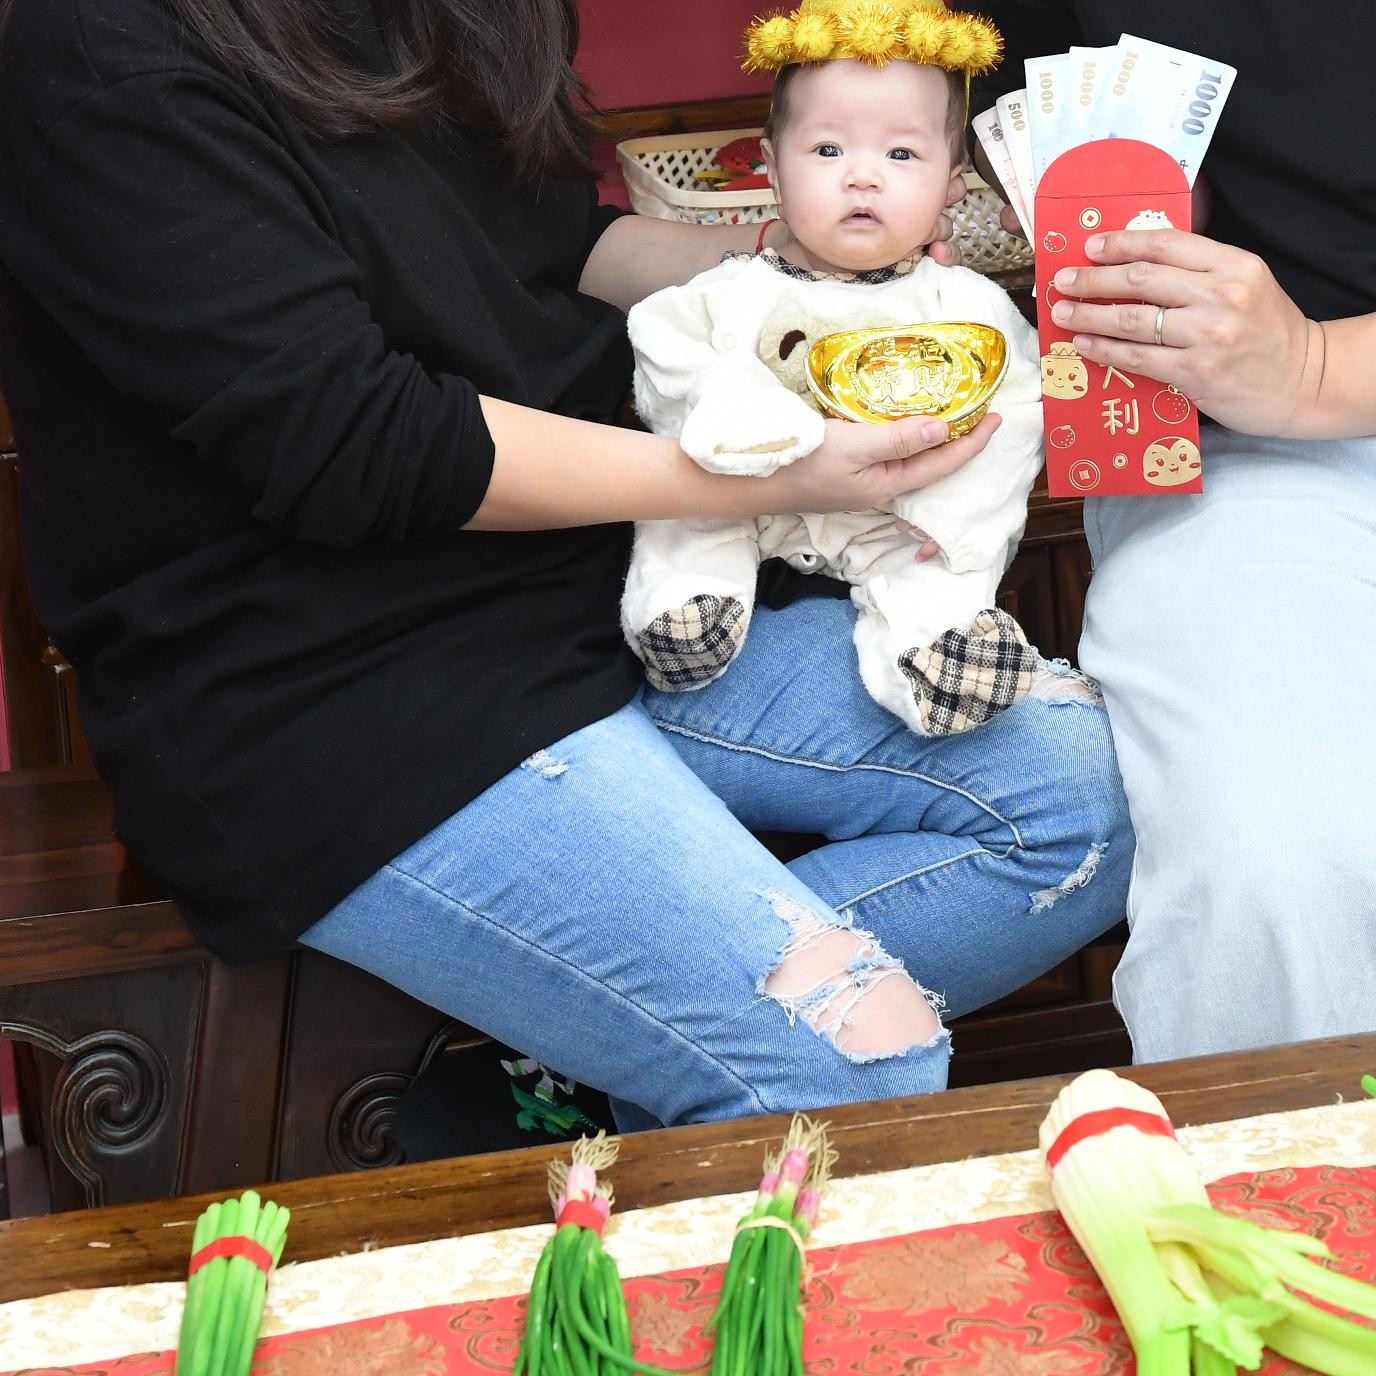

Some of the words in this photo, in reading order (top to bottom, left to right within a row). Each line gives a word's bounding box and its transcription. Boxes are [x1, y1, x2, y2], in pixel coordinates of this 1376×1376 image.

[1038, 71, 1055, 114] 1000
[1079, 59, 1097, 107] 1000
[1112, 50, 1139, 97] 1000
[1008, 102, 1026, 132] 500
[1181, 69, 1222, 136] 1000
[987, 122, 1004, 143] 100
